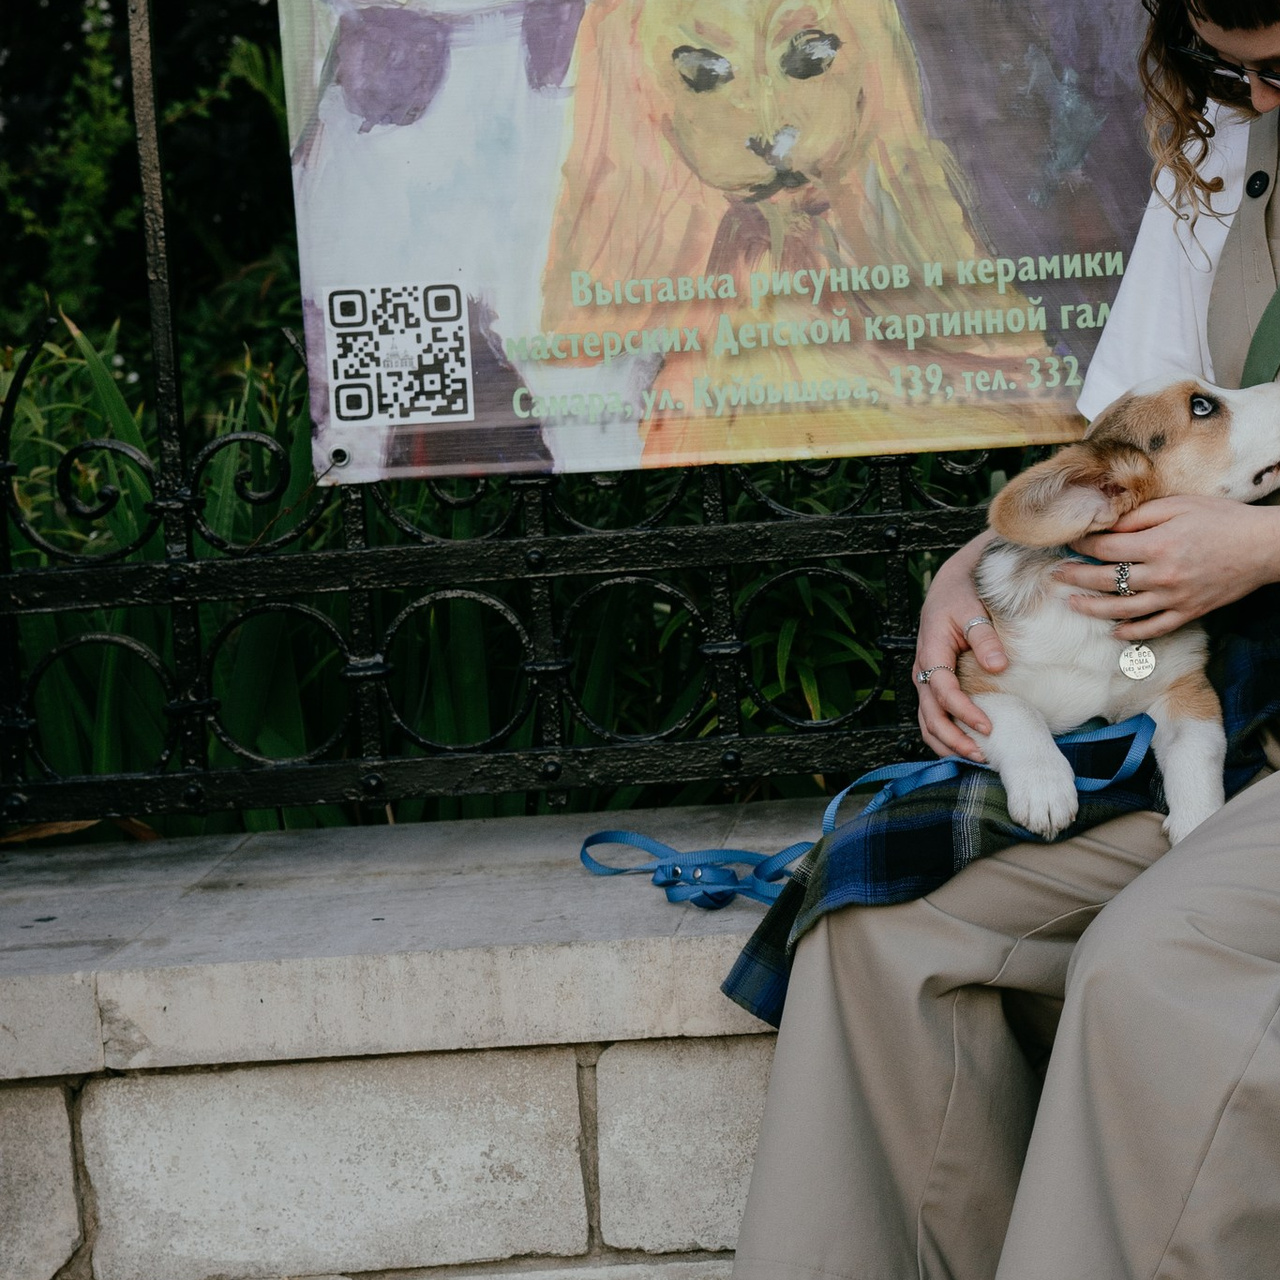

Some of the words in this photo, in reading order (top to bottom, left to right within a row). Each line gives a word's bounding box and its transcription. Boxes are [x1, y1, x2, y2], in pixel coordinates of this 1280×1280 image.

[570, 270, 737, 308] Выставка
[750, 264, 910, 310] рисунков
[924, 261, 943, 287] и
[957, 251, 1124, 294] керамики
[505, 325, 702, 366] мастерских
[714, 308, 851, 356] Детской
[865, 296, 1047, 350] картинной
[1061, 301, 1111, 329] гал
[512, 387, 632, 422] Самара,
[642, 388, 684, 420] ул.
[693, 374, 879, 416] Куйбышева,
[890, 363, 954, 400] 139,
[961, 368, 1017, 393] тел.
[1025, 355, 1082, 389] 332
